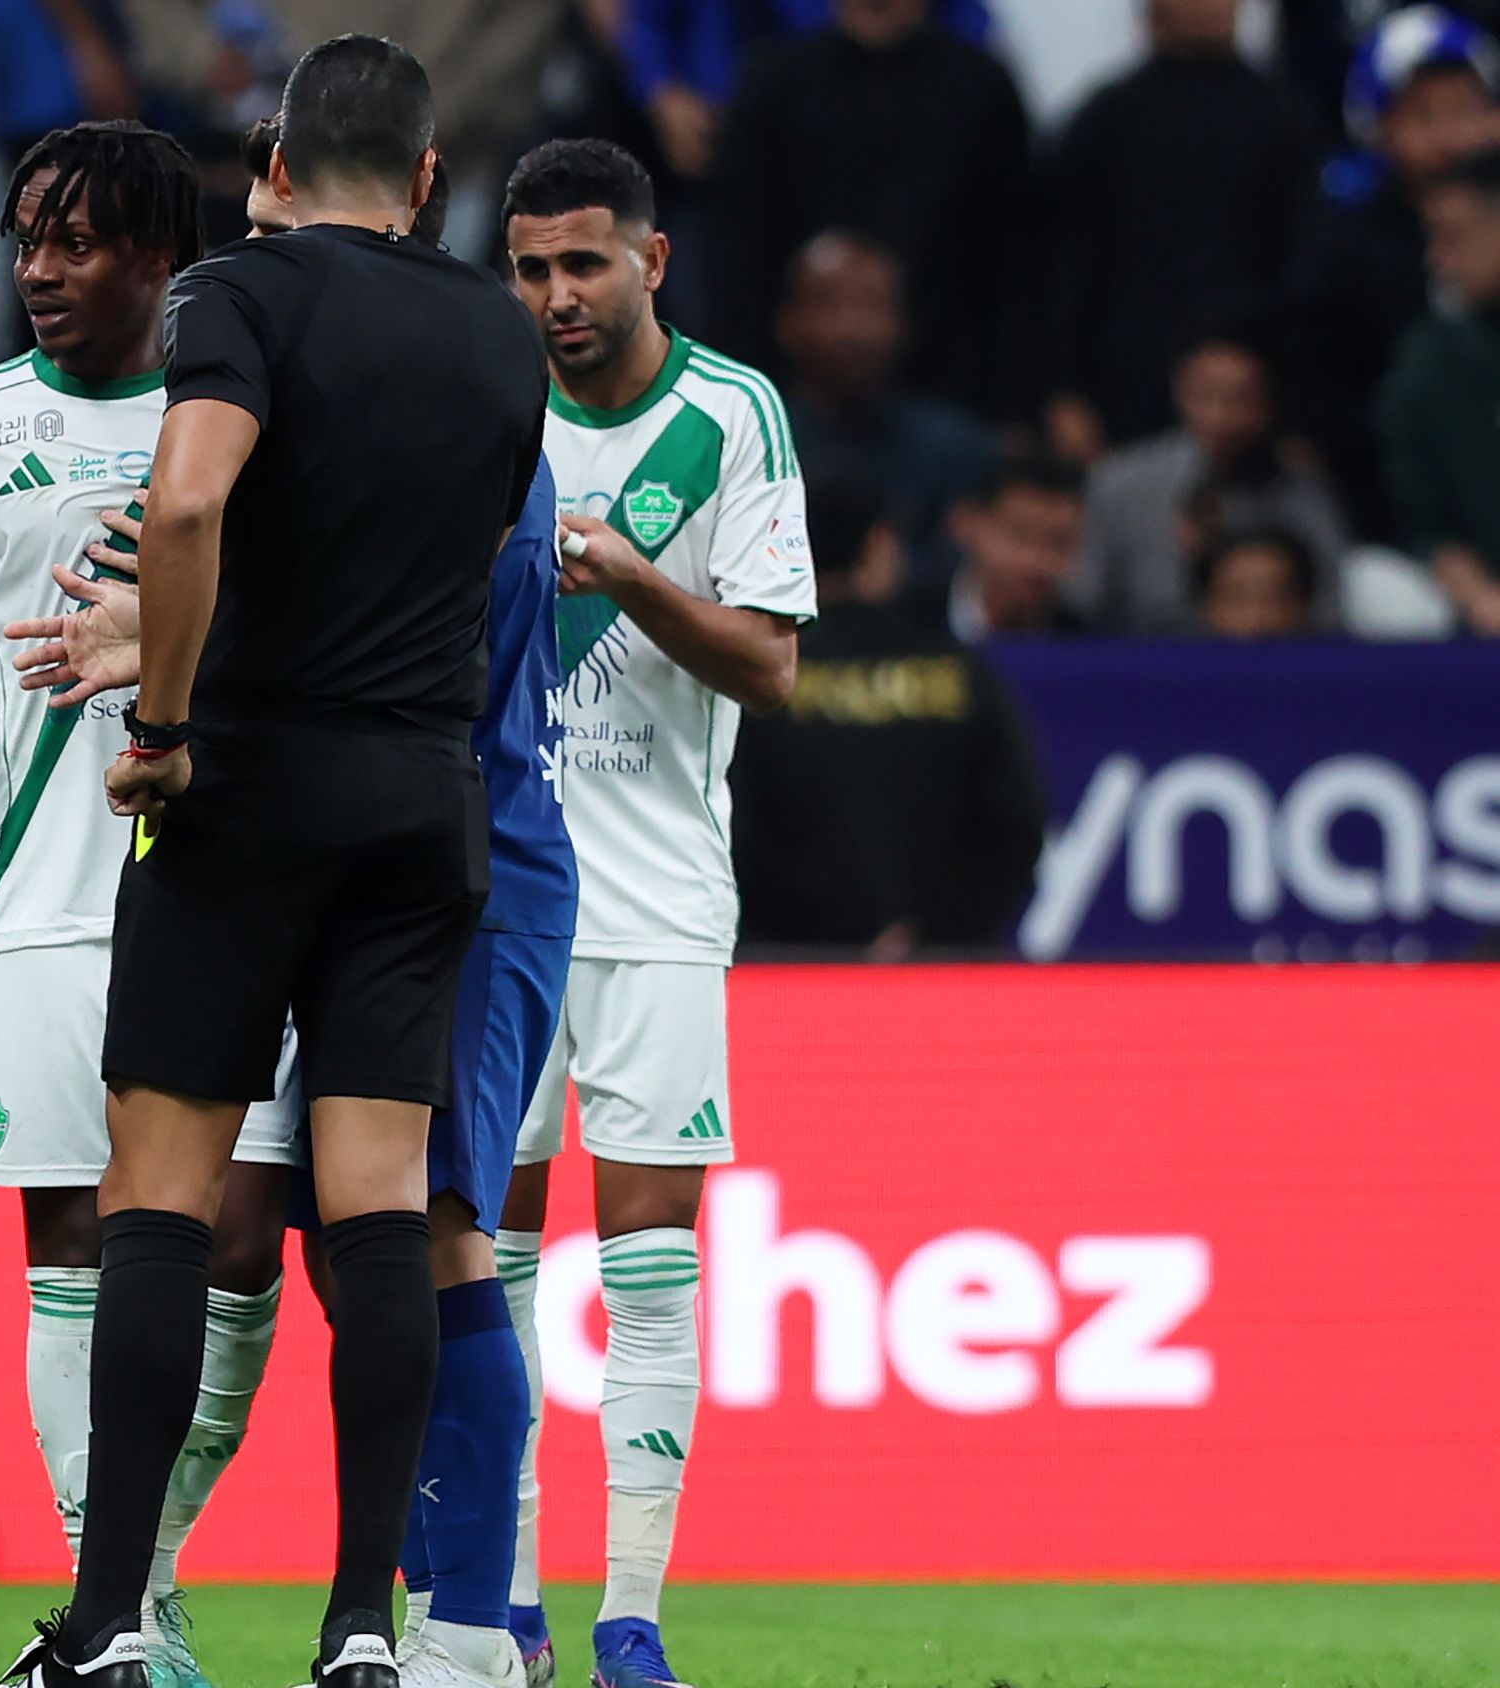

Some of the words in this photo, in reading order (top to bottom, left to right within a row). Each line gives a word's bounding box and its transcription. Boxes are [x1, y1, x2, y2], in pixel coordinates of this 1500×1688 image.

[68, 454, 106, 469] سرك
[69, 469, 107, 482] SIRC
[575, 750, 652, 774] Global
[347, 1644, 385, 1657] adidas
